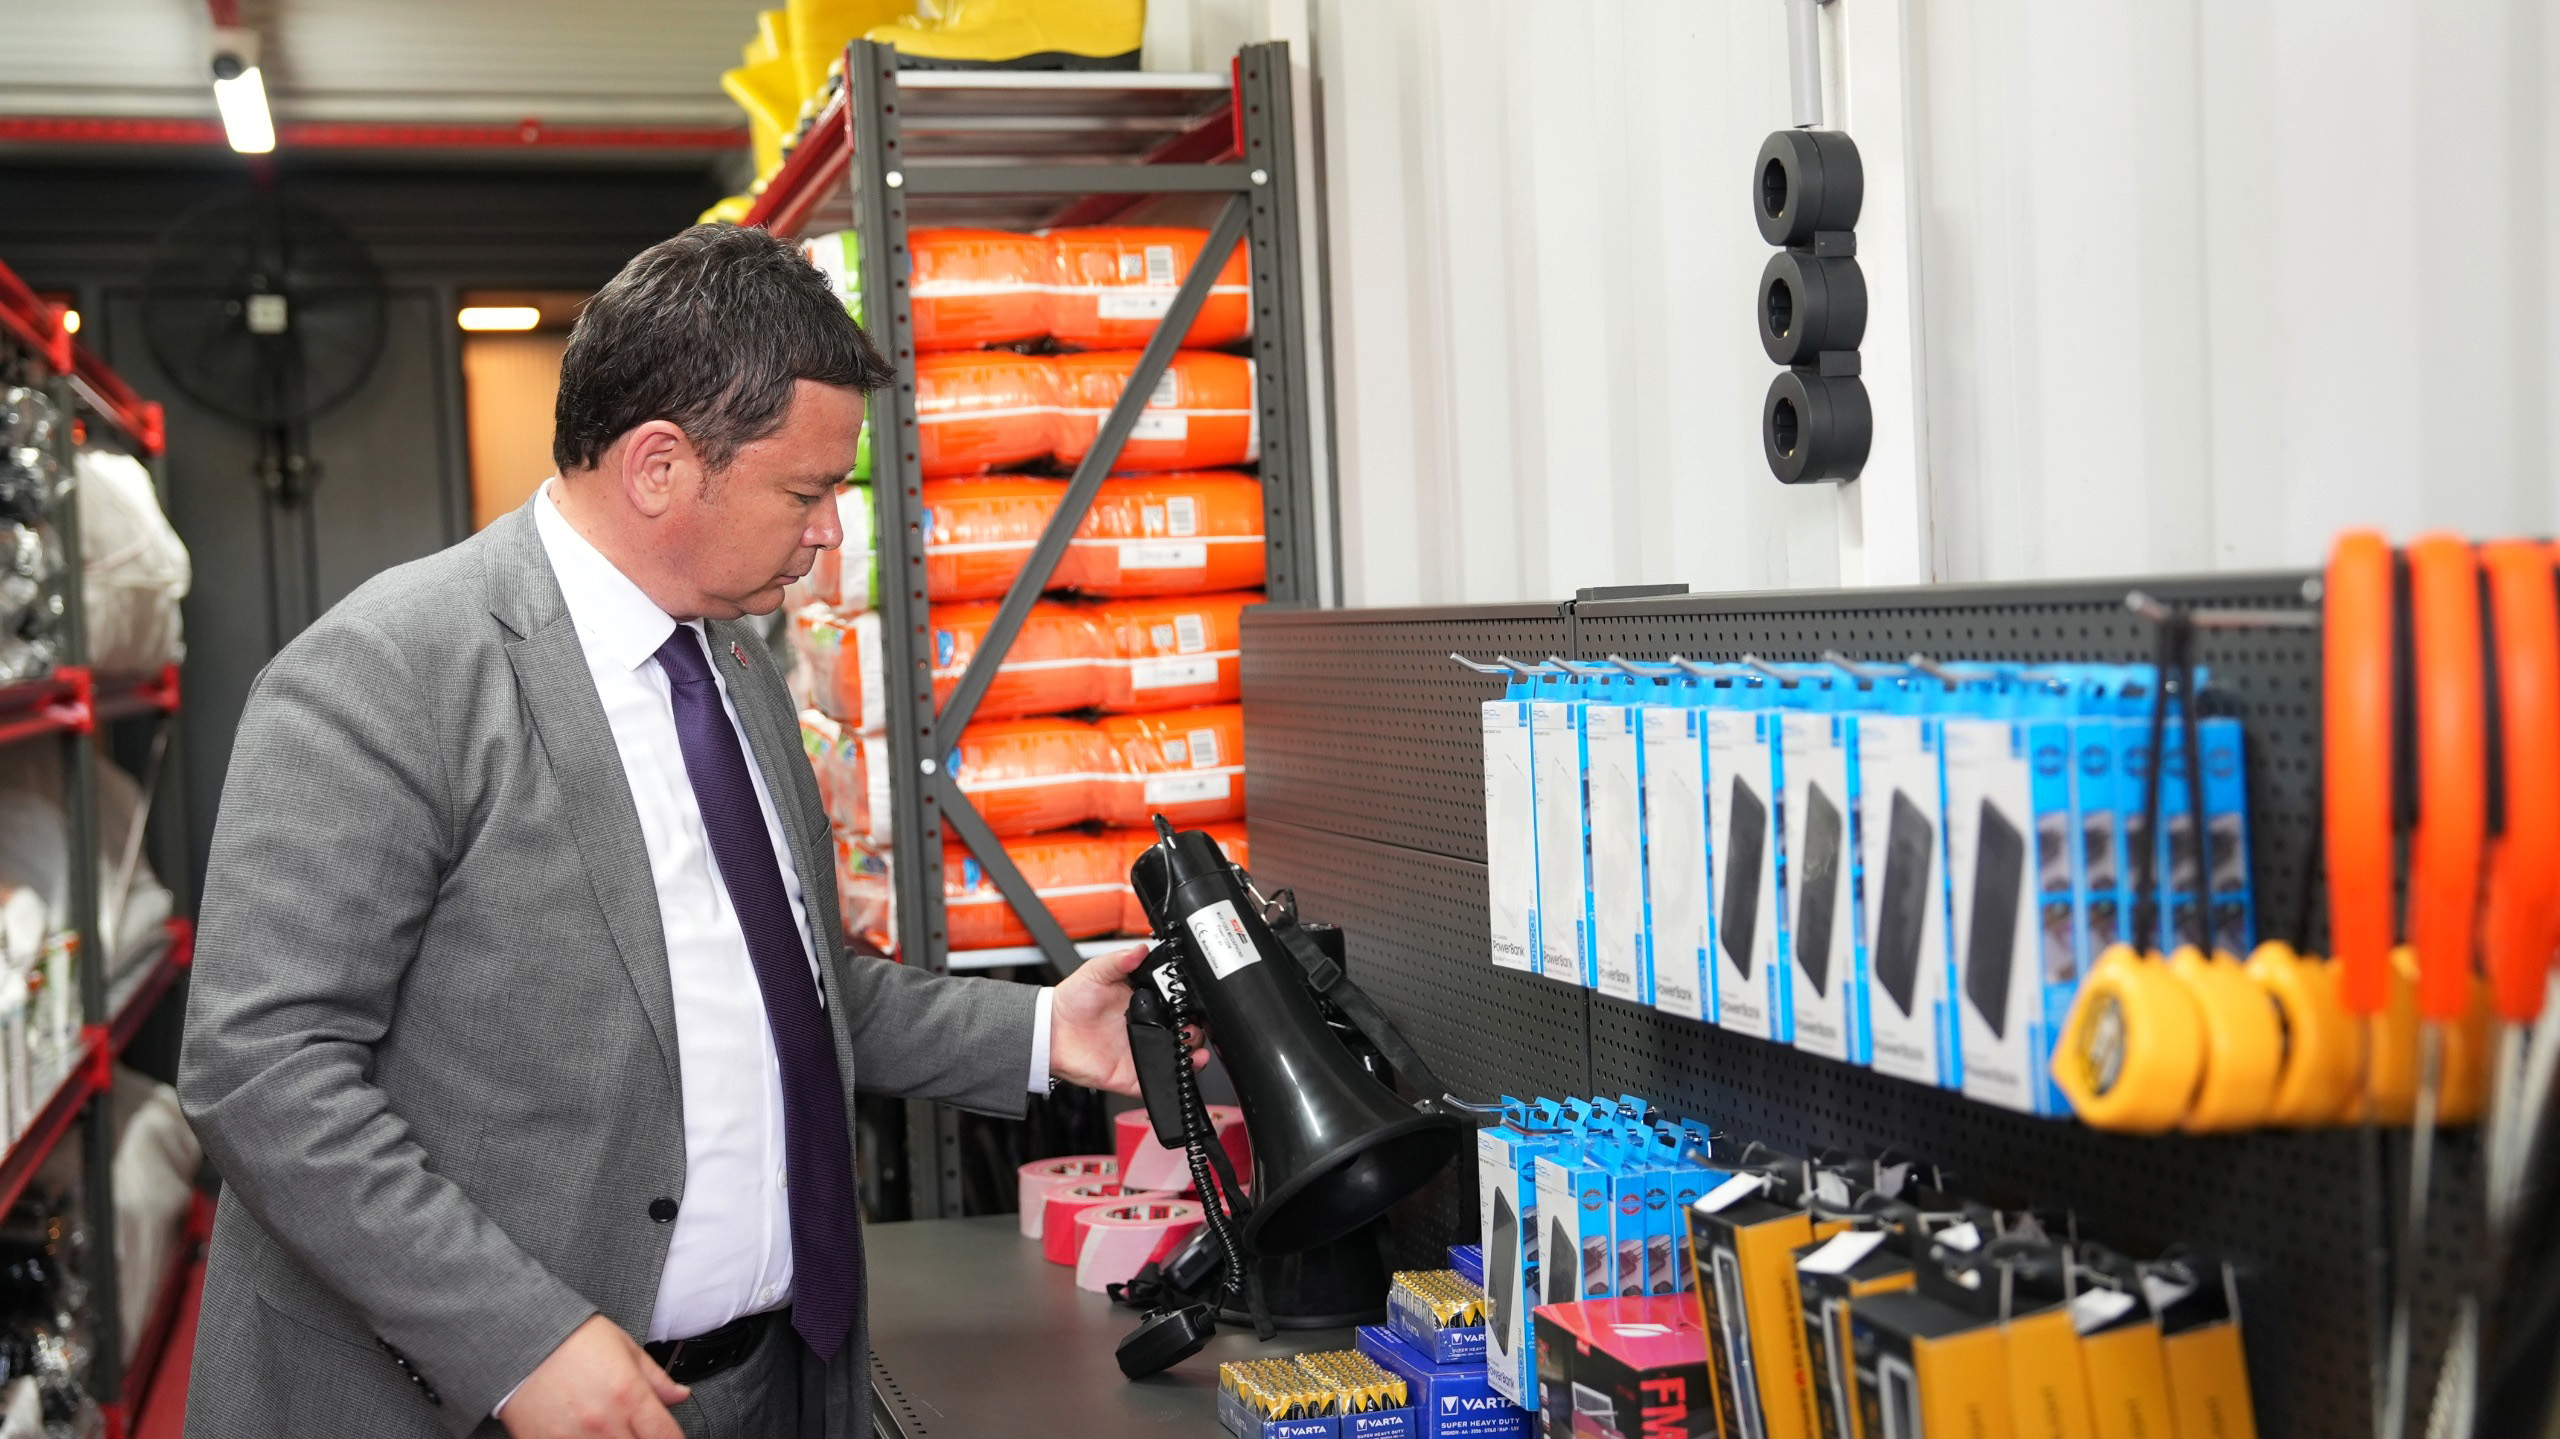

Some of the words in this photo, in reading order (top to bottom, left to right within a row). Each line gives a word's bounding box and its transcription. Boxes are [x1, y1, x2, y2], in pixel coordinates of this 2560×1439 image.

[1492, 940, 1524, 956] PowerBank
[1544, 951, 1573, 968] PowerBank
[1464, 1334, 1486, 1342] VAR
[1638, 1376, 1689, 1439] FM
[1368, 1416, 1404, 1427] VARTA
[1441, 1421, 1468, 1429] SUPER
[1470, 1418, 1496, 1427] HEAVY
[1291, 1426, 1326, 1436] VARTA
